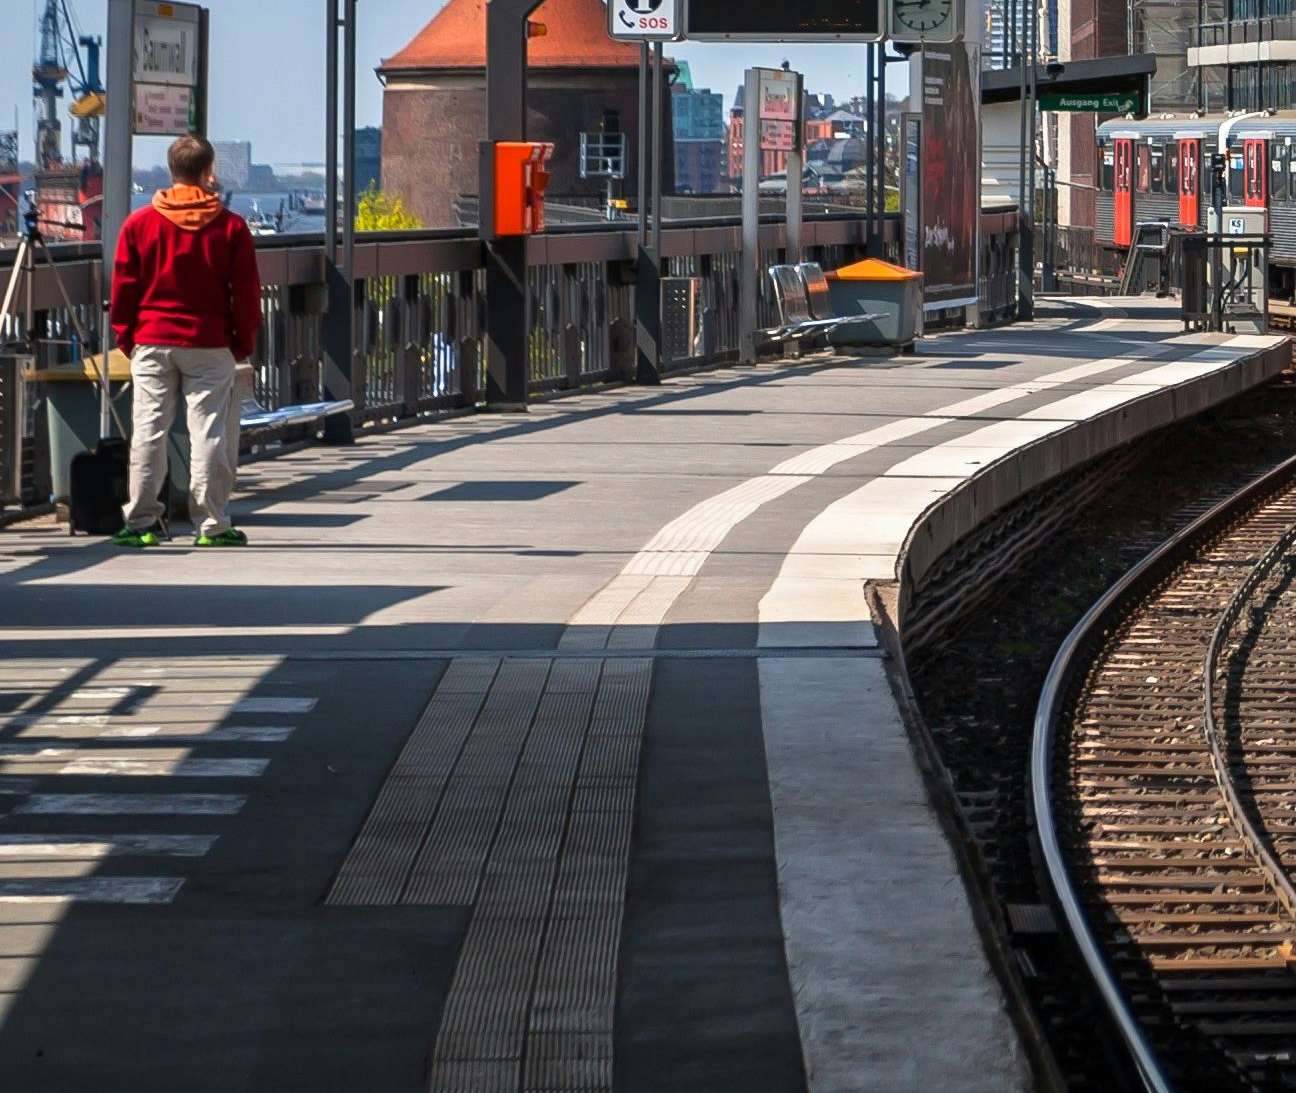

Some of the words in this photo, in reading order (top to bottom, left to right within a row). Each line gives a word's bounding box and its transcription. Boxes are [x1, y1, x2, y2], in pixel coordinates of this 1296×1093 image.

[638, 17, 669, 30] SOS
[1059, 97, 1100, 109] Ausgang
[1102, 97, 1120, 108] Exit
